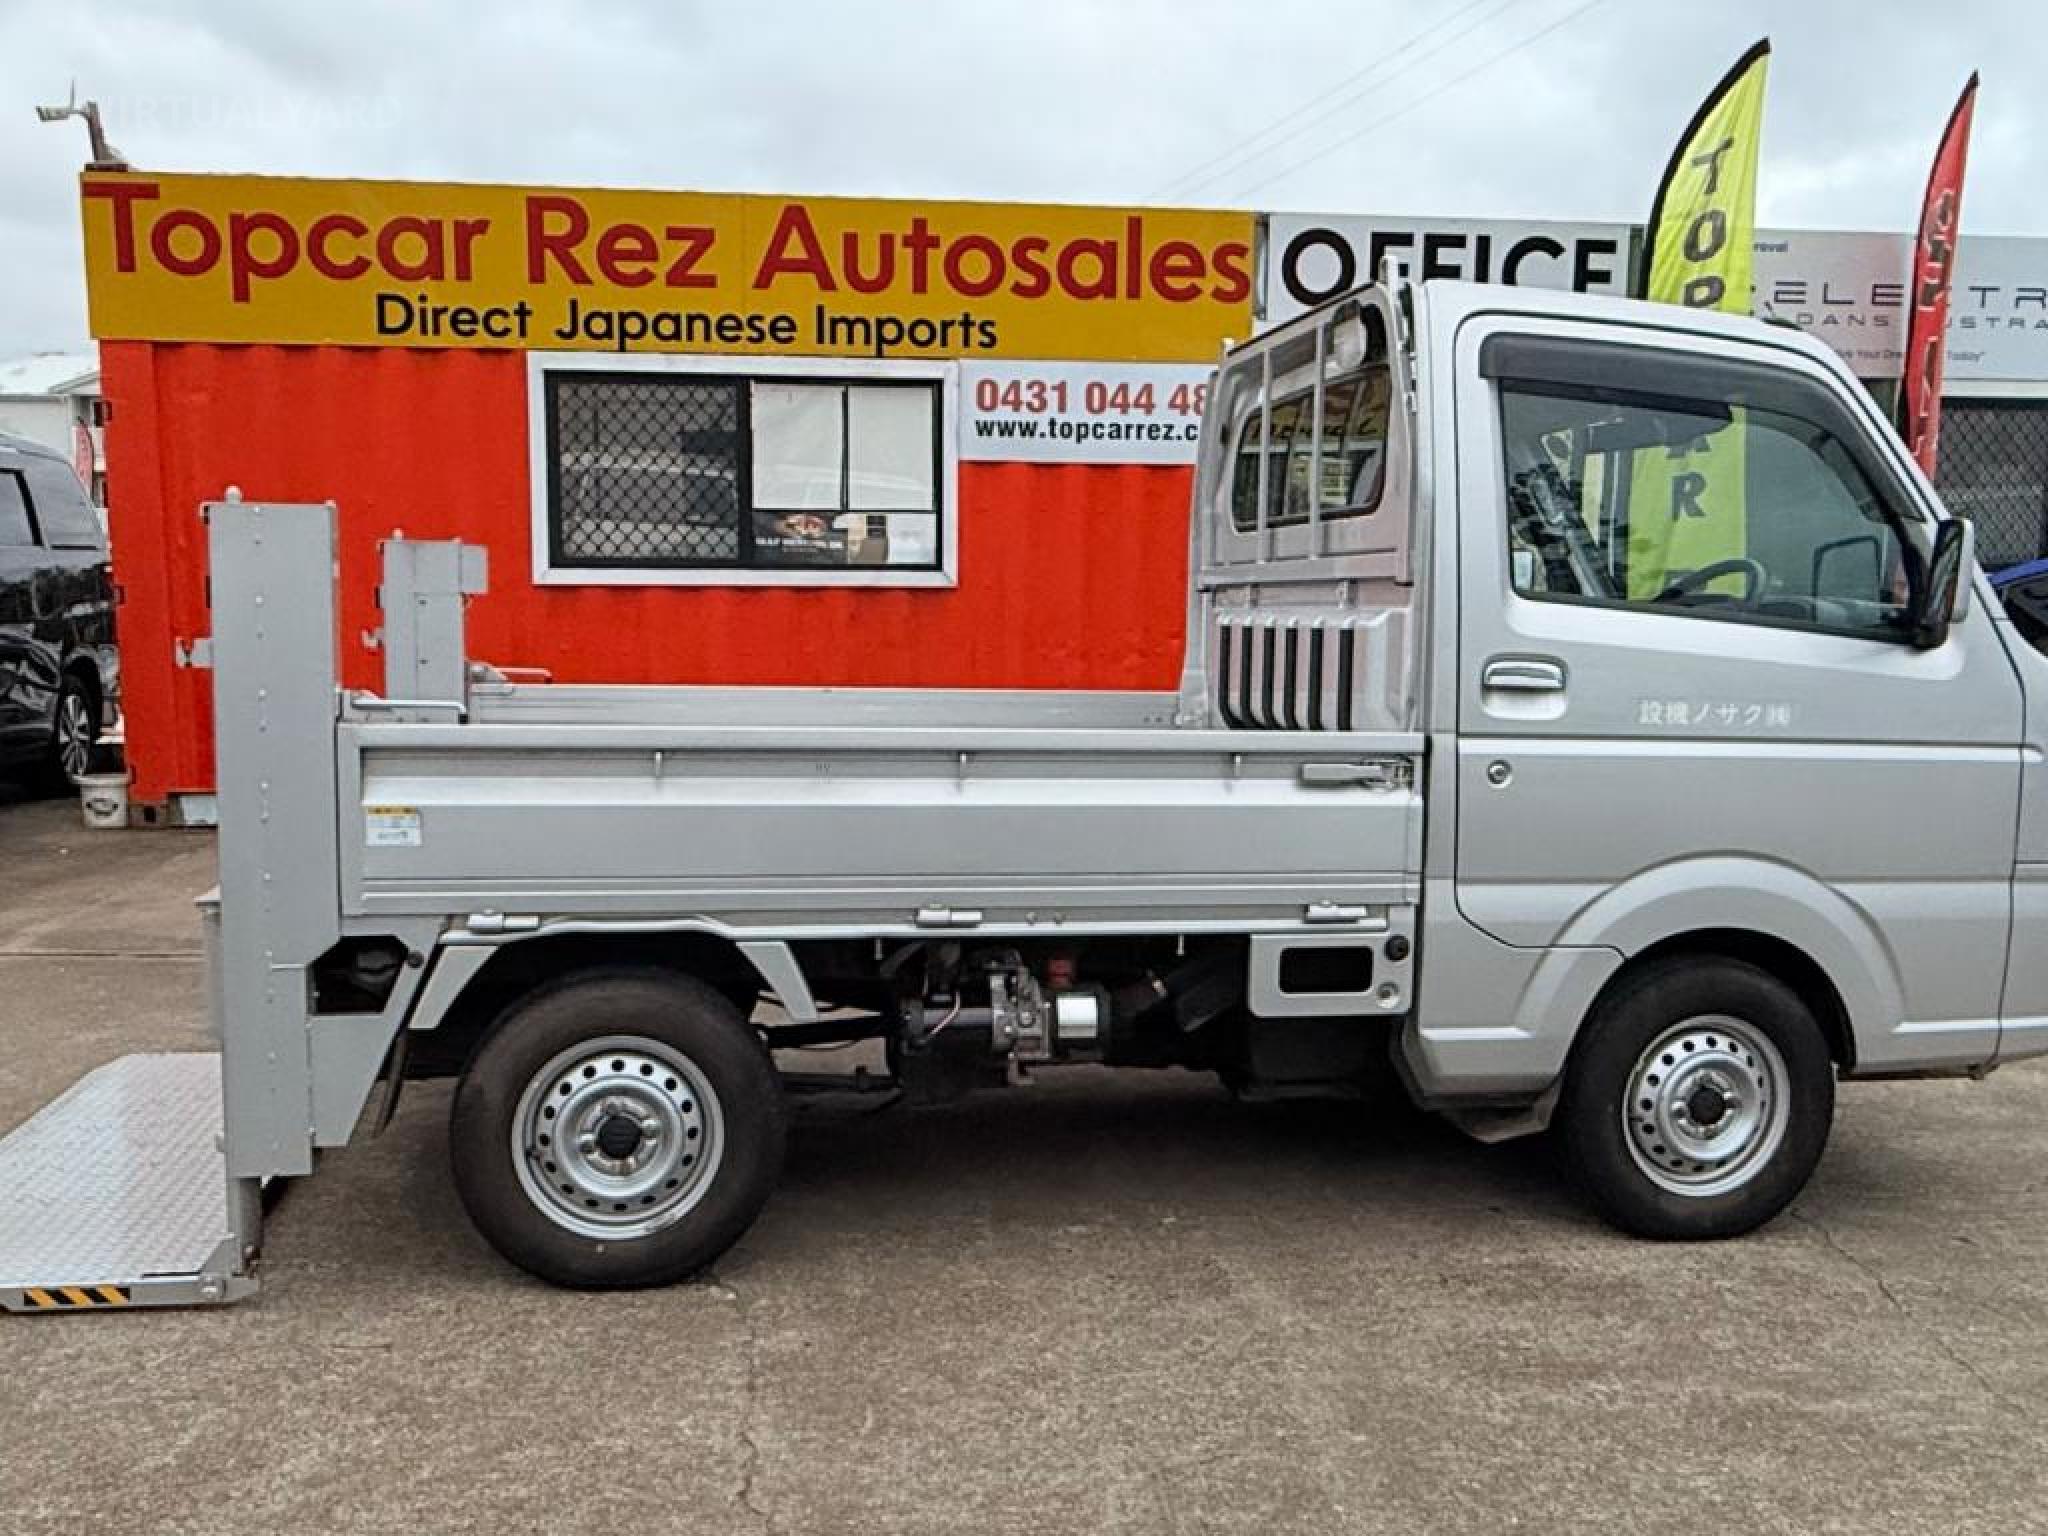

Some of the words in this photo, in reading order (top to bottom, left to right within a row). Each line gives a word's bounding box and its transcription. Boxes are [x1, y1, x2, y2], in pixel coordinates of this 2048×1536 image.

[84, 180, 490, 304] Topcar
[525, 194, 717, 290] Rez
[752, 203, 1251, 303] Autosales
[1281, 227, 1618, 306] OFFICE
[375, 293, 532, 338] Direct
[555, 298, 798, 354] Japanese
[815, 304, 998, 358] Imports
[975, 377, 1068, 414] 0431
[1084, 380, 1157, 415] 044
